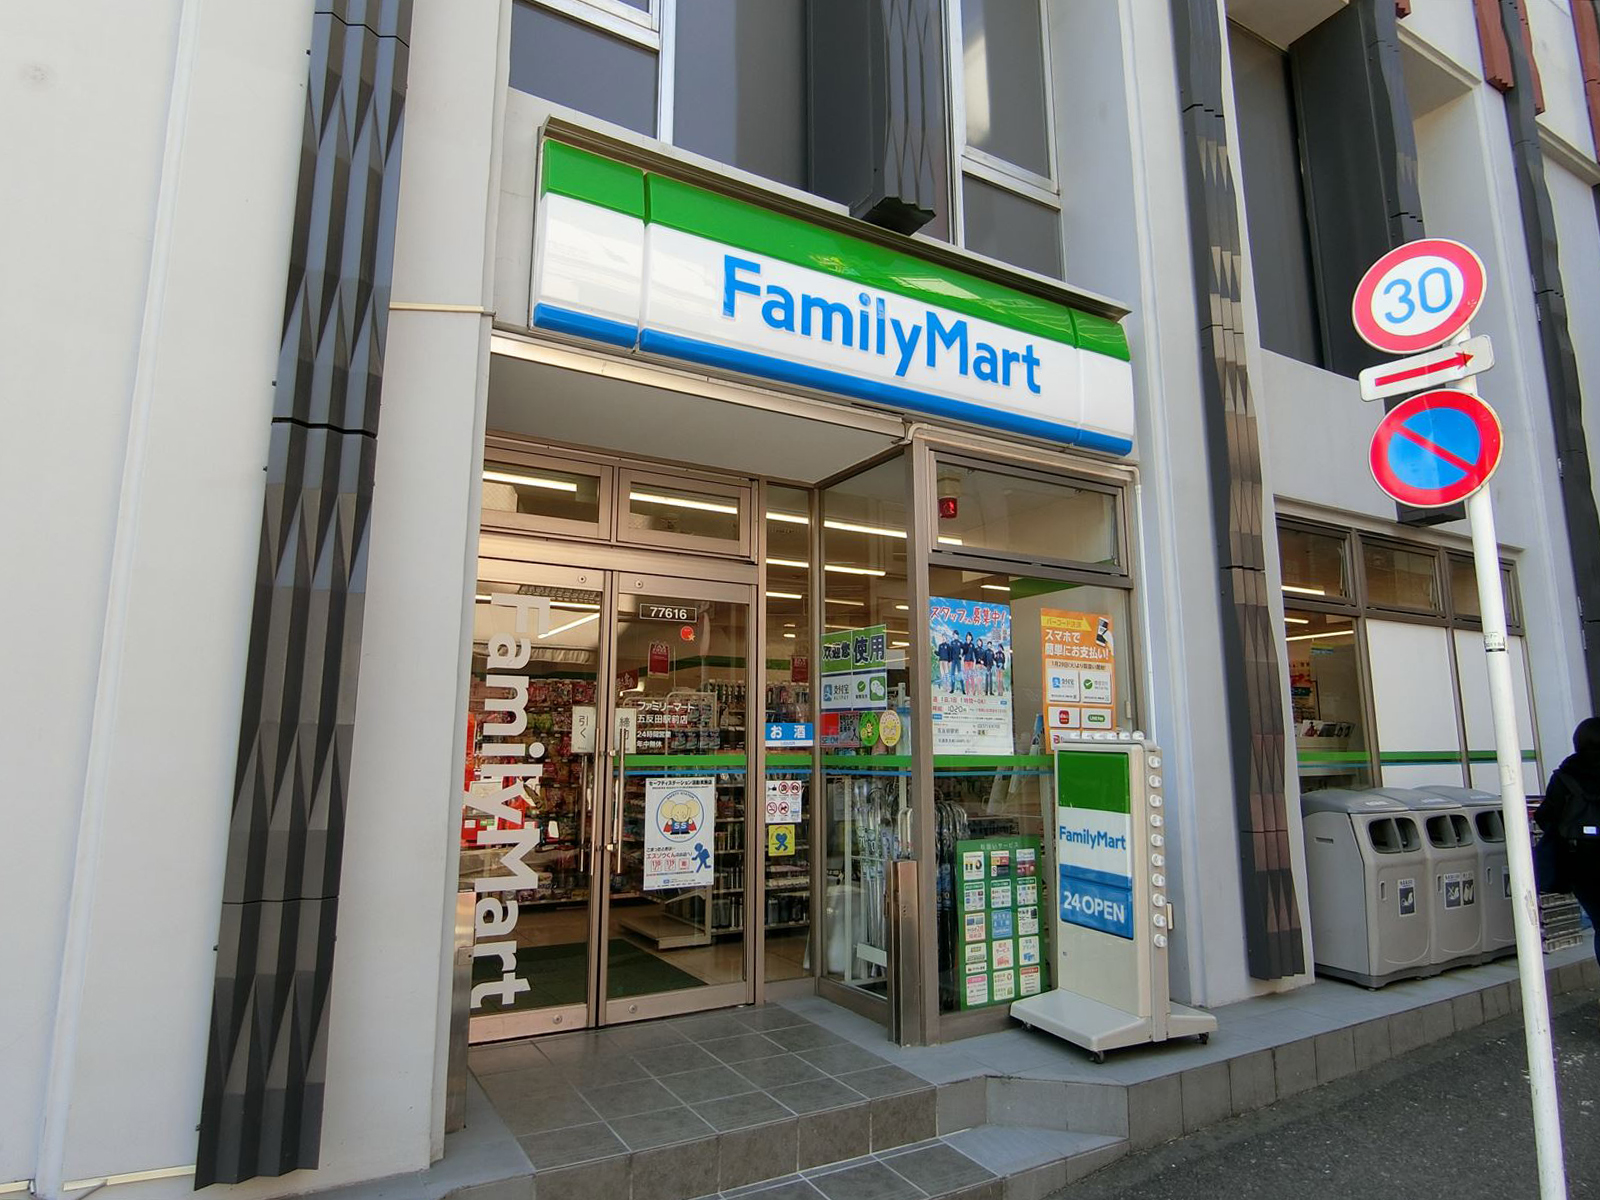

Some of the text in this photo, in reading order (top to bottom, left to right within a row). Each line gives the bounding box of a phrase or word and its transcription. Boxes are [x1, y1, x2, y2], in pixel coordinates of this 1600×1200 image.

[1383, 266, 1453, 324] 30
[722, 254, 1041, 395] FamilyMart
[650, 606, 687, 620] 77616
[1045, 629, 1081, 643] スマホで
[637, 701, 695, 713] ファミリーマート
[578, 714, 589, 739] 引く
[770, 724, 806, 739] お酒
[463, 593, 550, 1009] FamilyMart
[1059, 825, 1127, 851] FamilyMart
